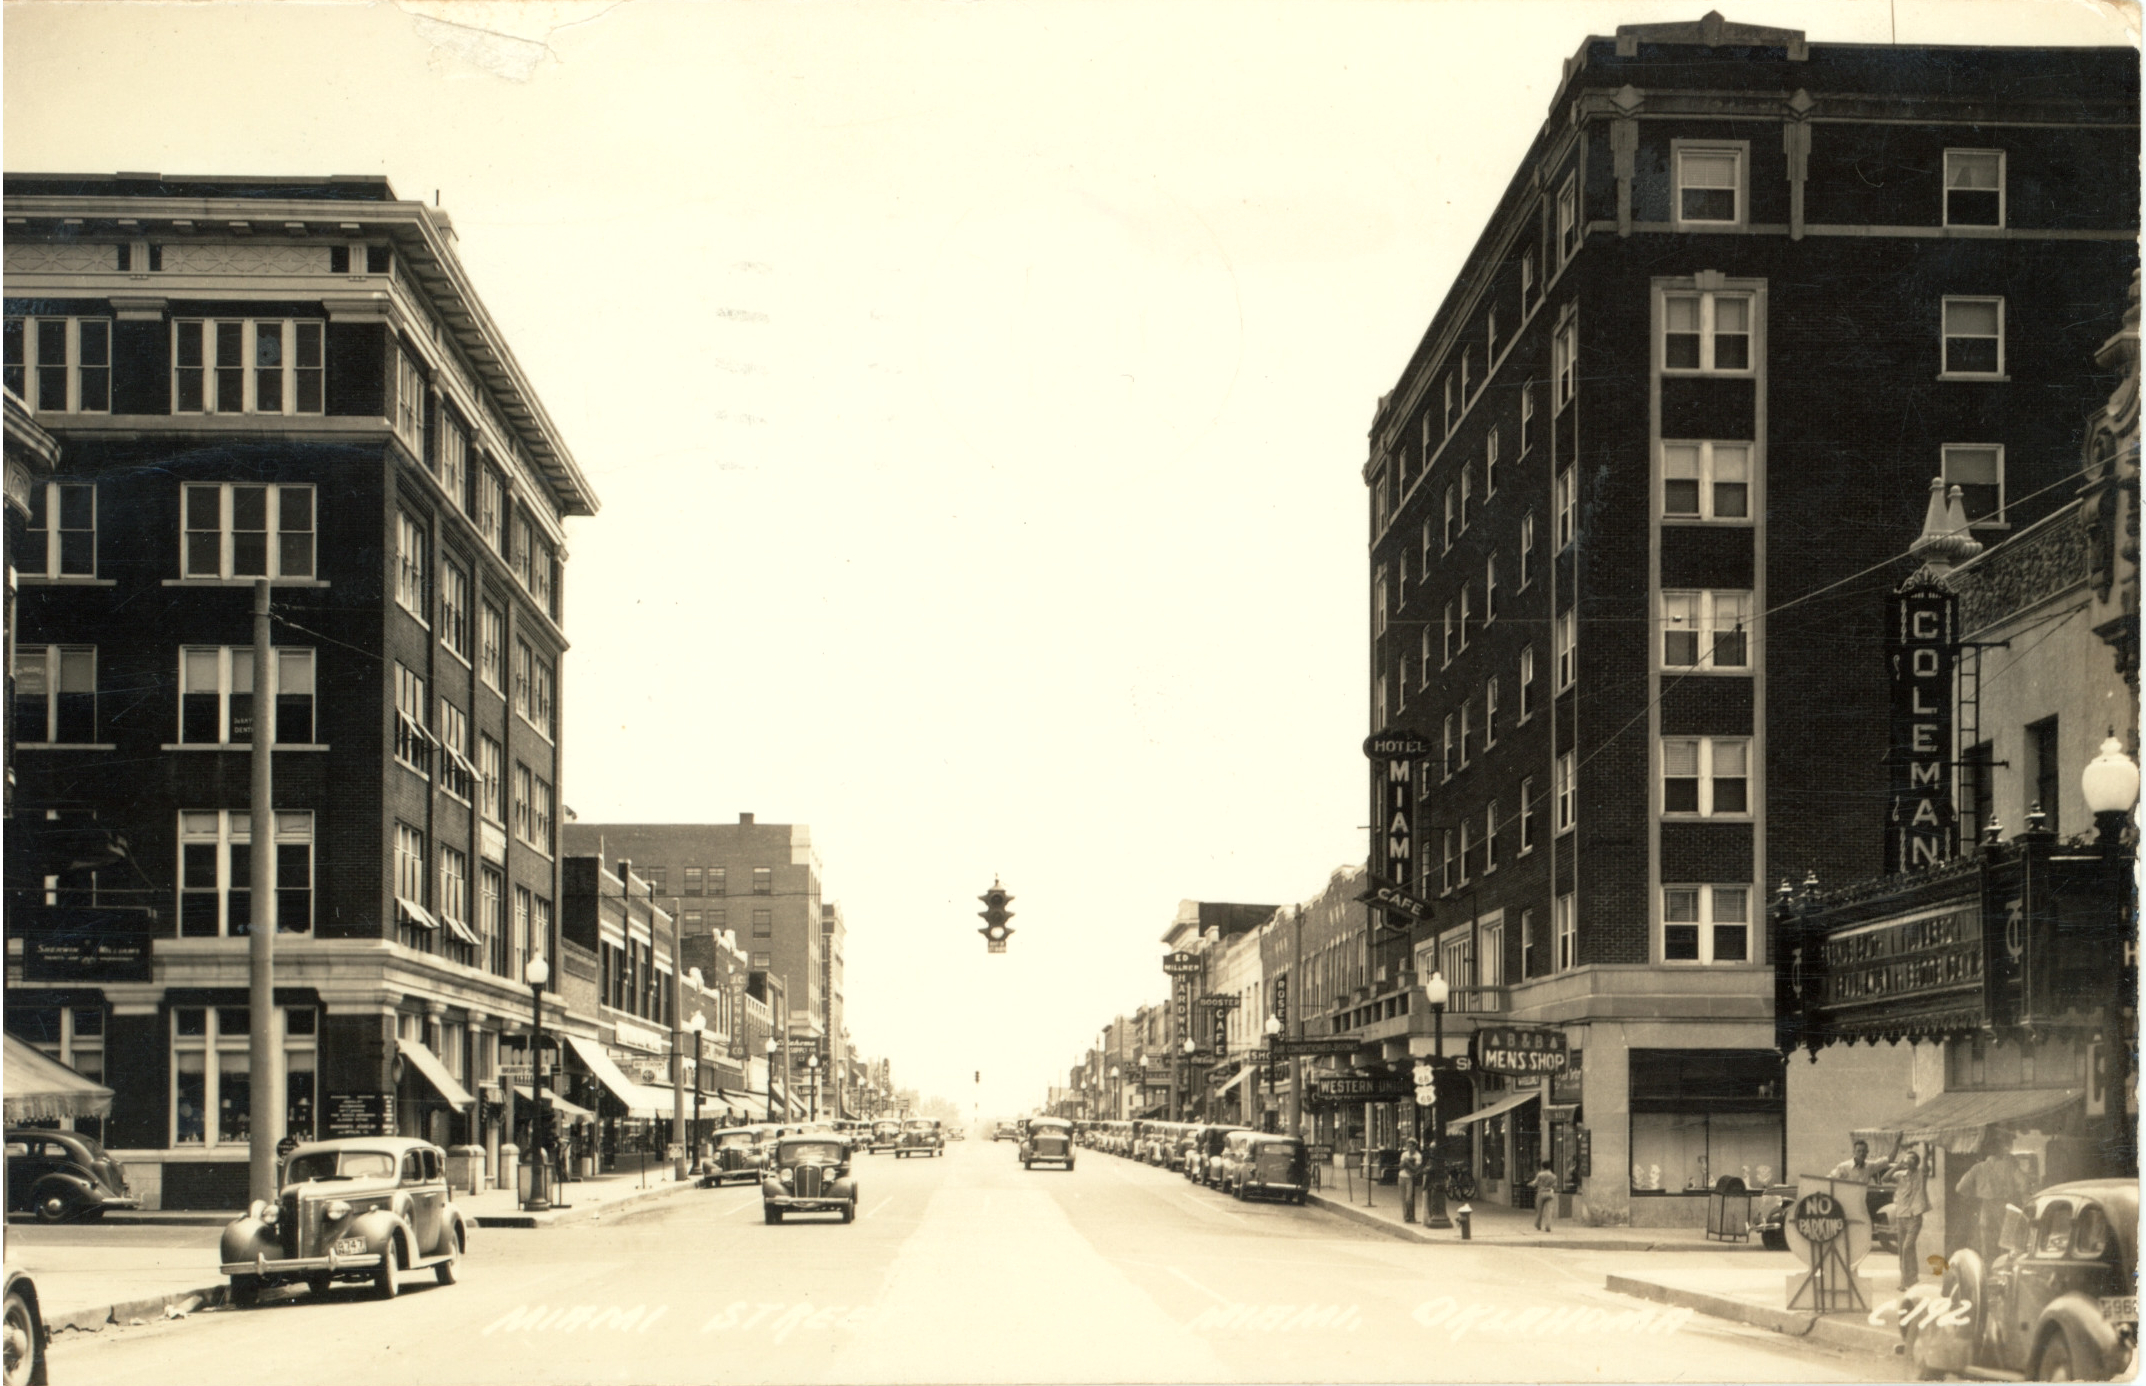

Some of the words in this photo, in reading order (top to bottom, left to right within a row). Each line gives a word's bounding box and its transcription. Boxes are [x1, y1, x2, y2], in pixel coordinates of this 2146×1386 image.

[1374, 740, 1427, 753] HOTEL
[1911, 610, 1940, 865] COLEMAN
[1390, 760, 1410, 885] MIAMI
[1378, 887, 1424, 916] CAFE
[1175, 953, 1189, 962] ED
[1200, 998, 1240, 1006] BOOSTER
[1177, 974, 1186, 1056] HARDWARE
[1216, 1009, 1224, 1055] CAFE
[1507, 1032, 1516, 1048] B
[1521, 1032, 1531, 1048] &
[1535, 1034, 1543, 1049] B
[1529, 1051, 1565, 1072] SHOP
[1320, 1080, 1374, 1094] WESTERN
[1806, 1196, 1833, 1215] NO
[1799, 1217, 1844, 1243] PARKING
